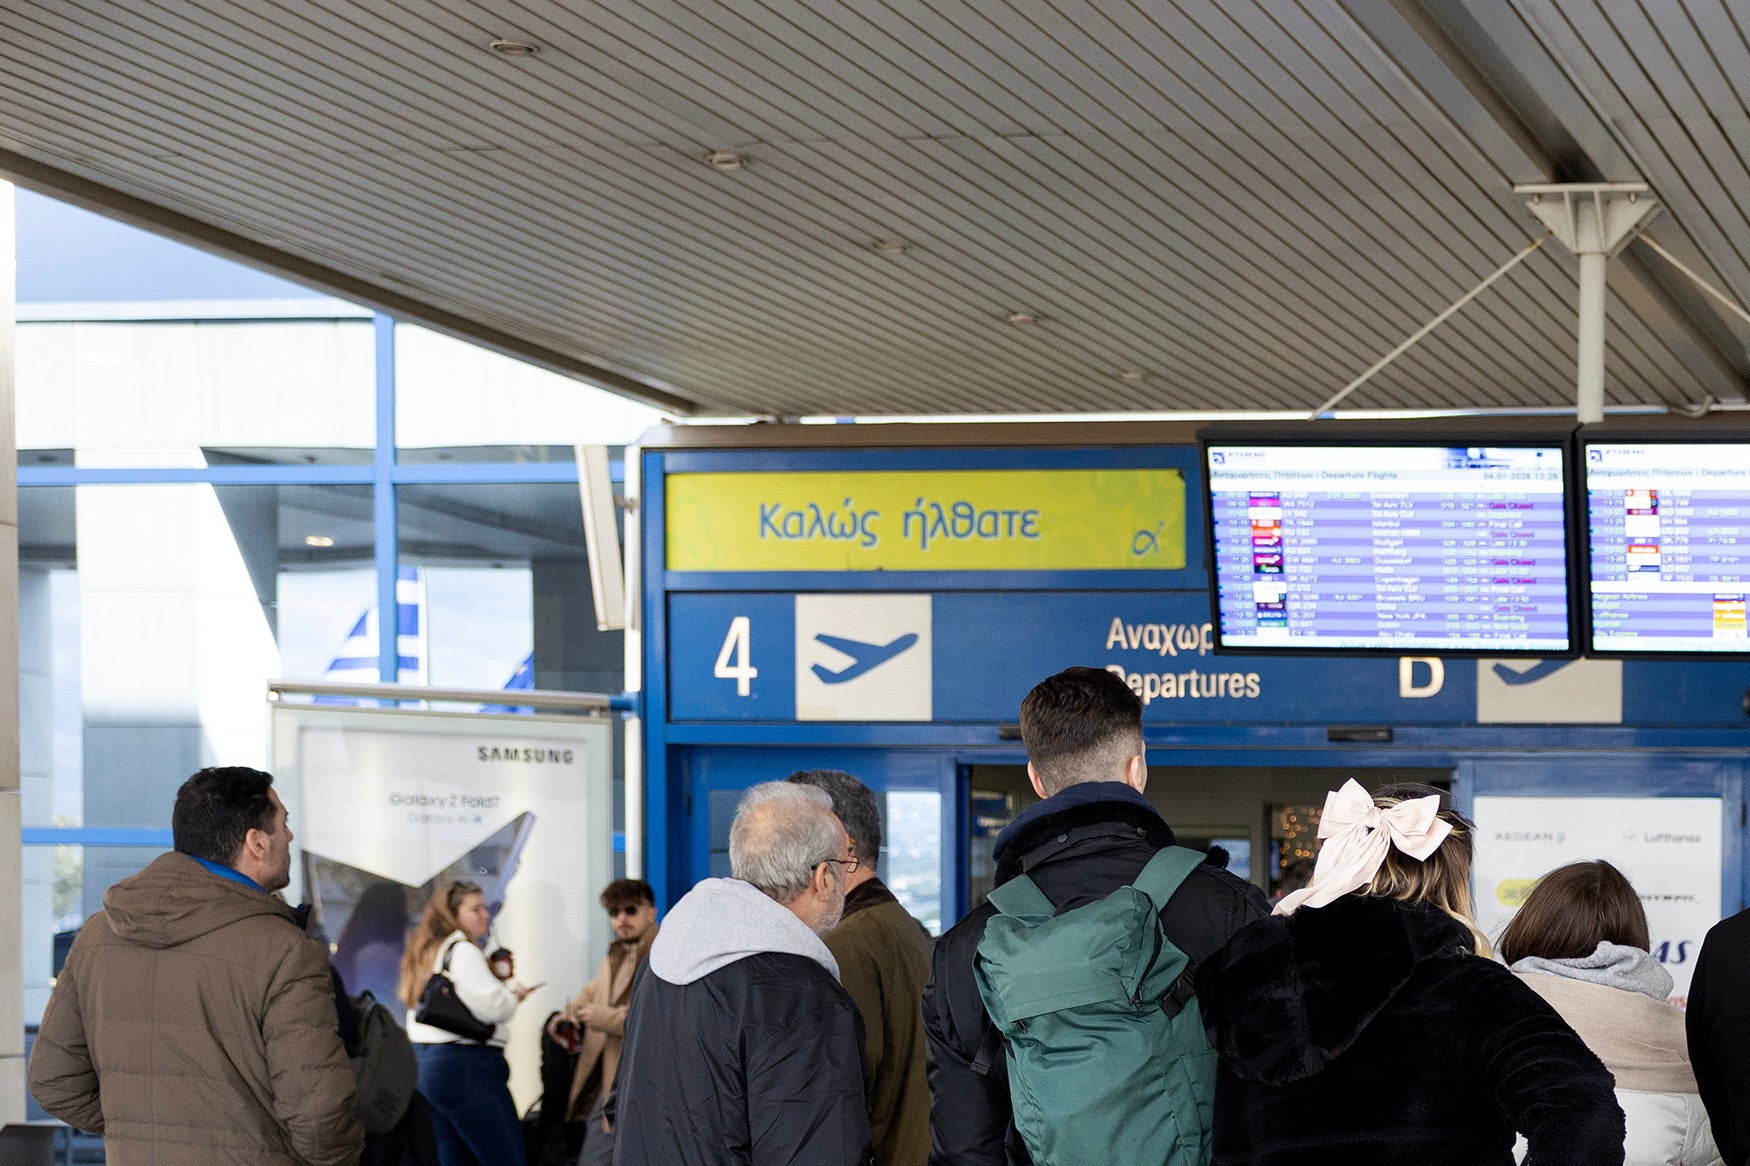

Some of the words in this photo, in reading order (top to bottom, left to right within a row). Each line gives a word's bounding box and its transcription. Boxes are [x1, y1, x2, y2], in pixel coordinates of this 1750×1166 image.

[1367, 471, 1398, 480] Flights
[760, 498, 880, 546] Καλώς
[903, 498, 1039, 550] ήλθατε
[1106, 617, 1213, 657] Αναχωρ
[714, 616, 757, 697] 4
[477, 745, 574, 765] SAMSUNG
[389, 792, 445, 809] Galaxy
[449, 794, 458, 808] Z
[461, 794, 501, 809] Fold7
[1495, 832, 1553, 842] AEGEAN
[1645, 832, 1702, 843] Lufthansa
[1656, 940, 1693, 964] AS
